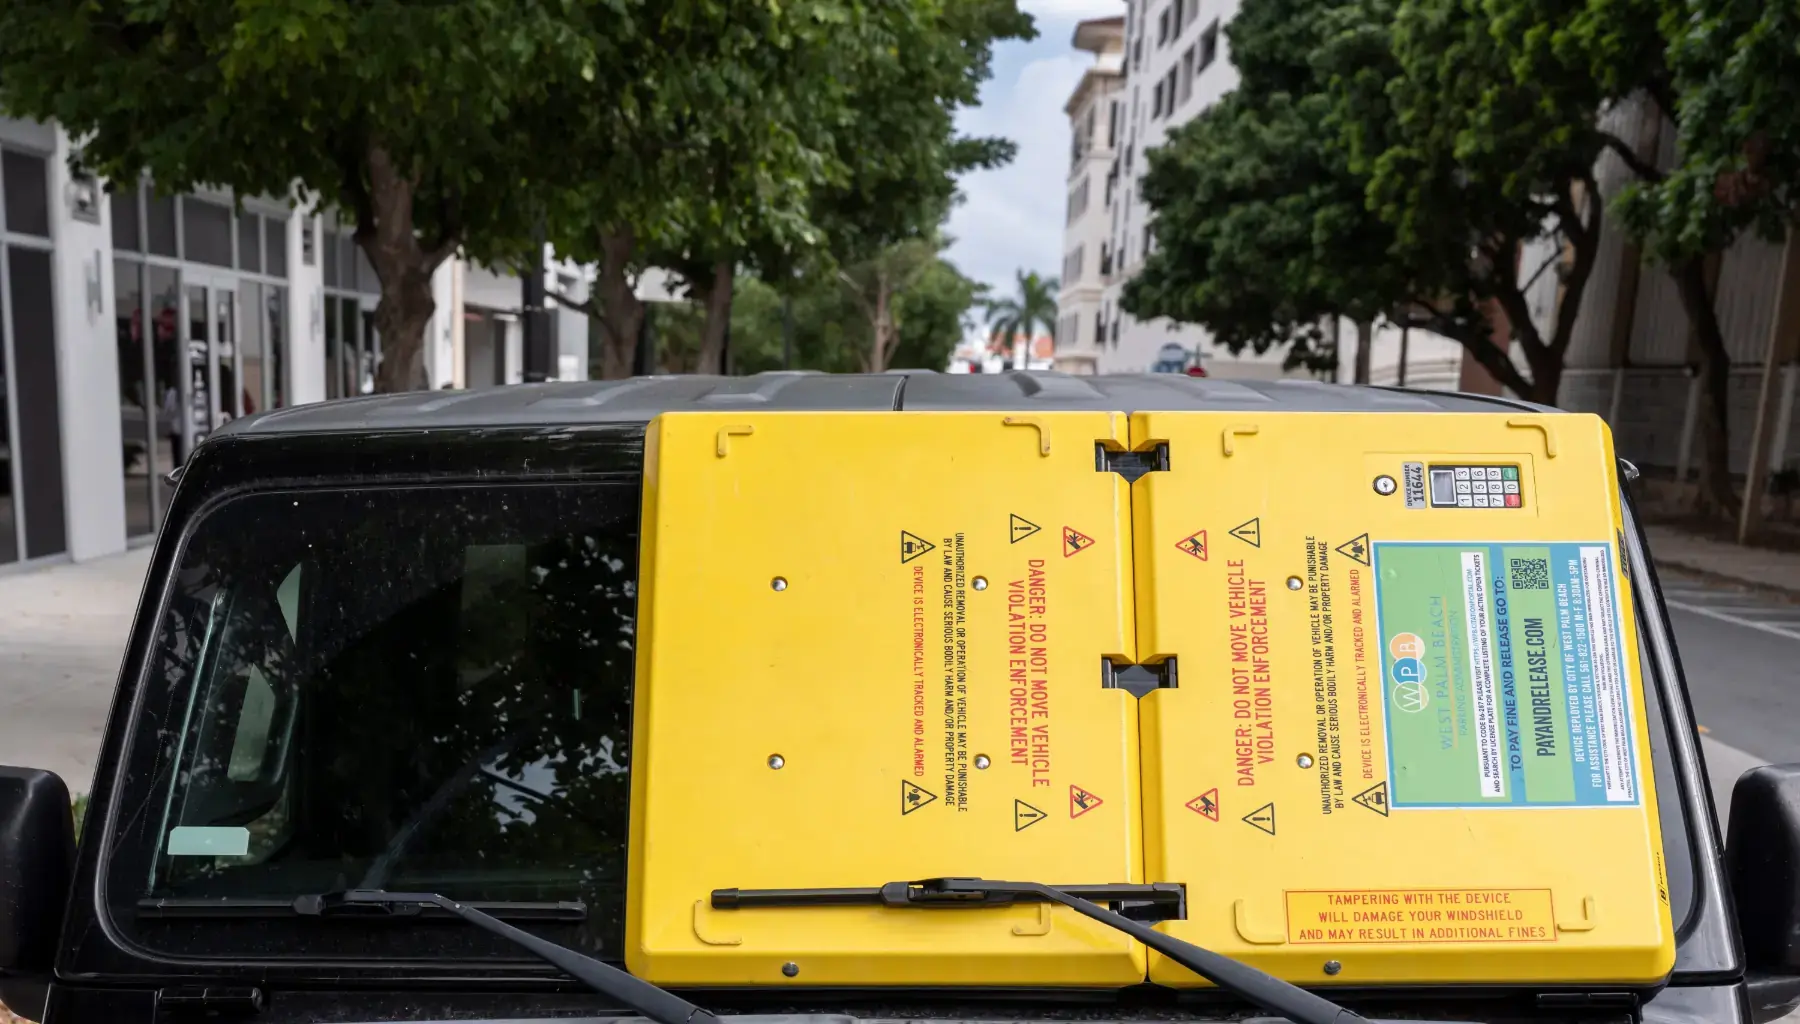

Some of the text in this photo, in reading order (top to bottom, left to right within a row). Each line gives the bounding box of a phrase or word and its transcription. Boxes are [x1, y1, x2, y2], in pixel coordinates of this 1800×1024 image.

[1411, 466, 1424, 501] 11644
[914, 567, 923, 594] DEVICE
[1350, 570, 1360, 606] ALARMED
[1352, 609, 1362, 624] AND
[1573, 607, 1584, 620] M-F
[914, 608, 924, 676] ELECTRONICALLY
[1353, 627, 1364, 662] TRACKED
[944, 539, 955, 805] BY LAW AND CAUSE SERIOUS BODILY HARM AND/OR PROPERTY DAMAGE
[956, 533, 967, 811] UNAUTHORIZED REMOVAL OR OPERATION OF VEHICLE MAY BE PUNISHABLE
[1008, 580, 1028, 765] VIOLATION ENFORCEMENT
[1029, 560, 1049, 786] DANGER: DO NOT MOVE VEHICLE
[1228, 560, 1254, 786] DANGER: DO NOT MOVE VEHICLE
[1249, 580, 1273, 764] VIOLATION ENFORCEMENT
[1306, 536, 1331, 814] UNAUTHORIZED REMOVAL OR OPERATION OF VEHICLE MAY BE PUNISHABLE
[1318, 542, 1344, 808] BY LAW AND CAUSE SERIOUS BODILY HARM AND/OR PROPERTY DAMAGE
[1429, 596, 1453, 750] WEST PALM BEACH
[1483, 660, 1491, 688] COMPLETE
[1494, 576, 1522, 771] TO PAY FINE AND RELEASE GO TO:
[1524, 618, 1556, 756] PAYANDRELEASE.COM
[1557, 584, 1585, 762] DEVICE DEPLOYED BY CITY OF WEST PALM BEACH
[1580, 675, 1592, 693] CALL
[914, 680, 924, 716] TRACKED
[1356, 666, 1370, 735] ELECTRONICALLY
[1583, 696, 1595, 723] PLEASE
[914, 719, 924, 735] AND
[1488, 725, 1496, 747] LICENSE
[914, 738, 924, 776] ALARMED
[1362, 750, 1373, 778] DEVICE
[1482, 748, 1490, 777] PURSUANT
[1586, 726, 1600, 770] ASSISTANCE
[1491, 757, 1499, 779] SEARCH
[1591, 773, 1602, 787] FOR
[1319, 910, 1522, 922] WILL DAMAGE YOUR WINDSHIELD
[1328, 893, 1510, 905] TAMPERING WITH THE DEVICE
[1300, 927, 1545, 939] AND MAY RESULT IN ADDITIONAL FINES
